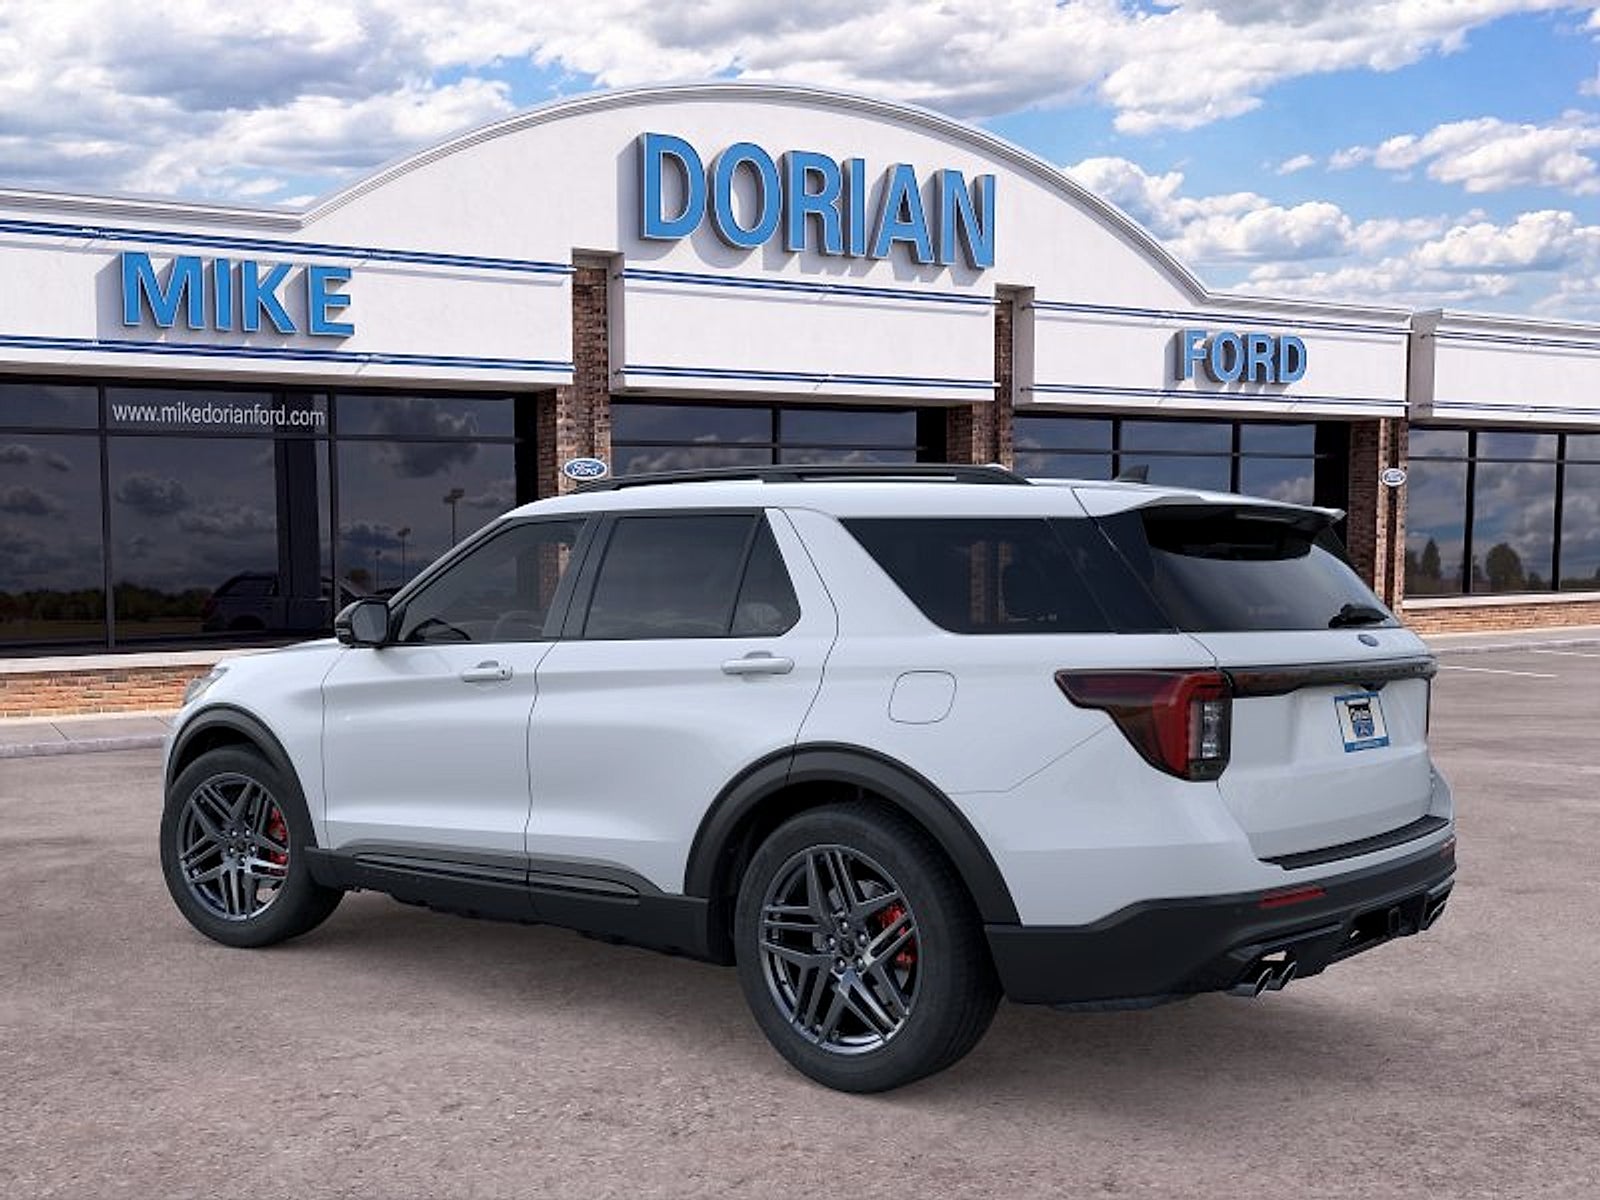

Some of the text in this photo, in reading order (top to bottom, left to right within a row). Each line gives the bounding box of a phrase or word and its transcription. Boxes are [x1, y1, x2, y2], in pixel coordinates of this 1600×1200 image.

[639, 132, 996, 270] DORIAN
[120, 251, 355, 337] MIKE
[1175, 327, 1308, 384] FORD
[111, 401, 326, 427] www.mikedorianford.com
